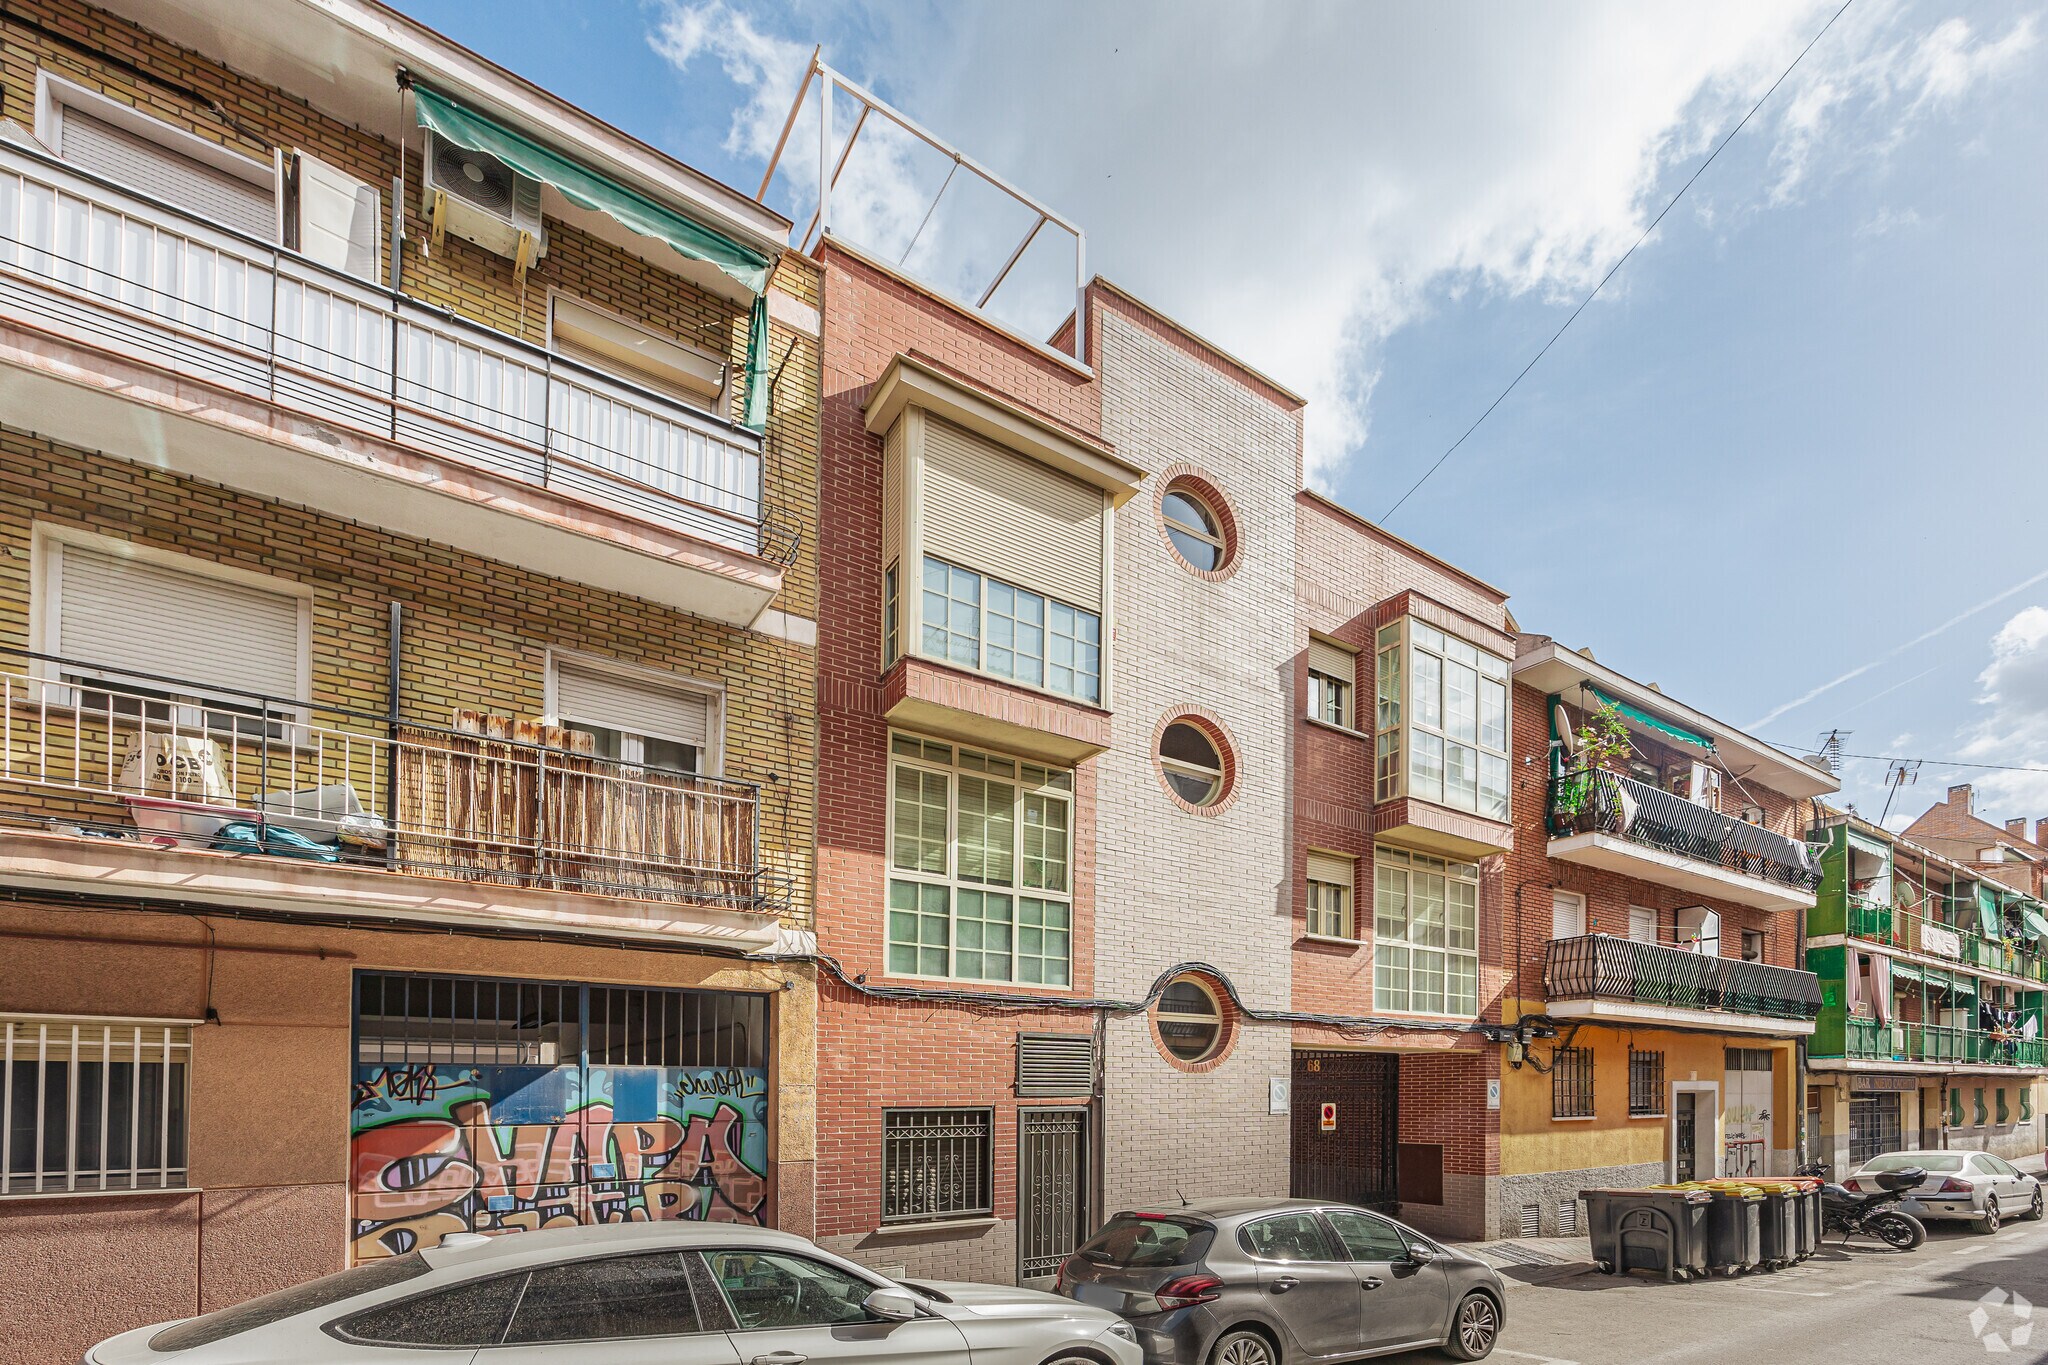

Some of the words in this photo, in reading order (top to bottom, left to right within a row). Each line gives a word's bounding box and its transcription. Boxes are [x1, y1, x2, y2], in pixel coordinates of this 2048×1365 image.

[156, 753, 201, 771] OCB
[1307, 1059, 1320, 1072] 68
[1857, 1077, 1871, 1089] BAR
